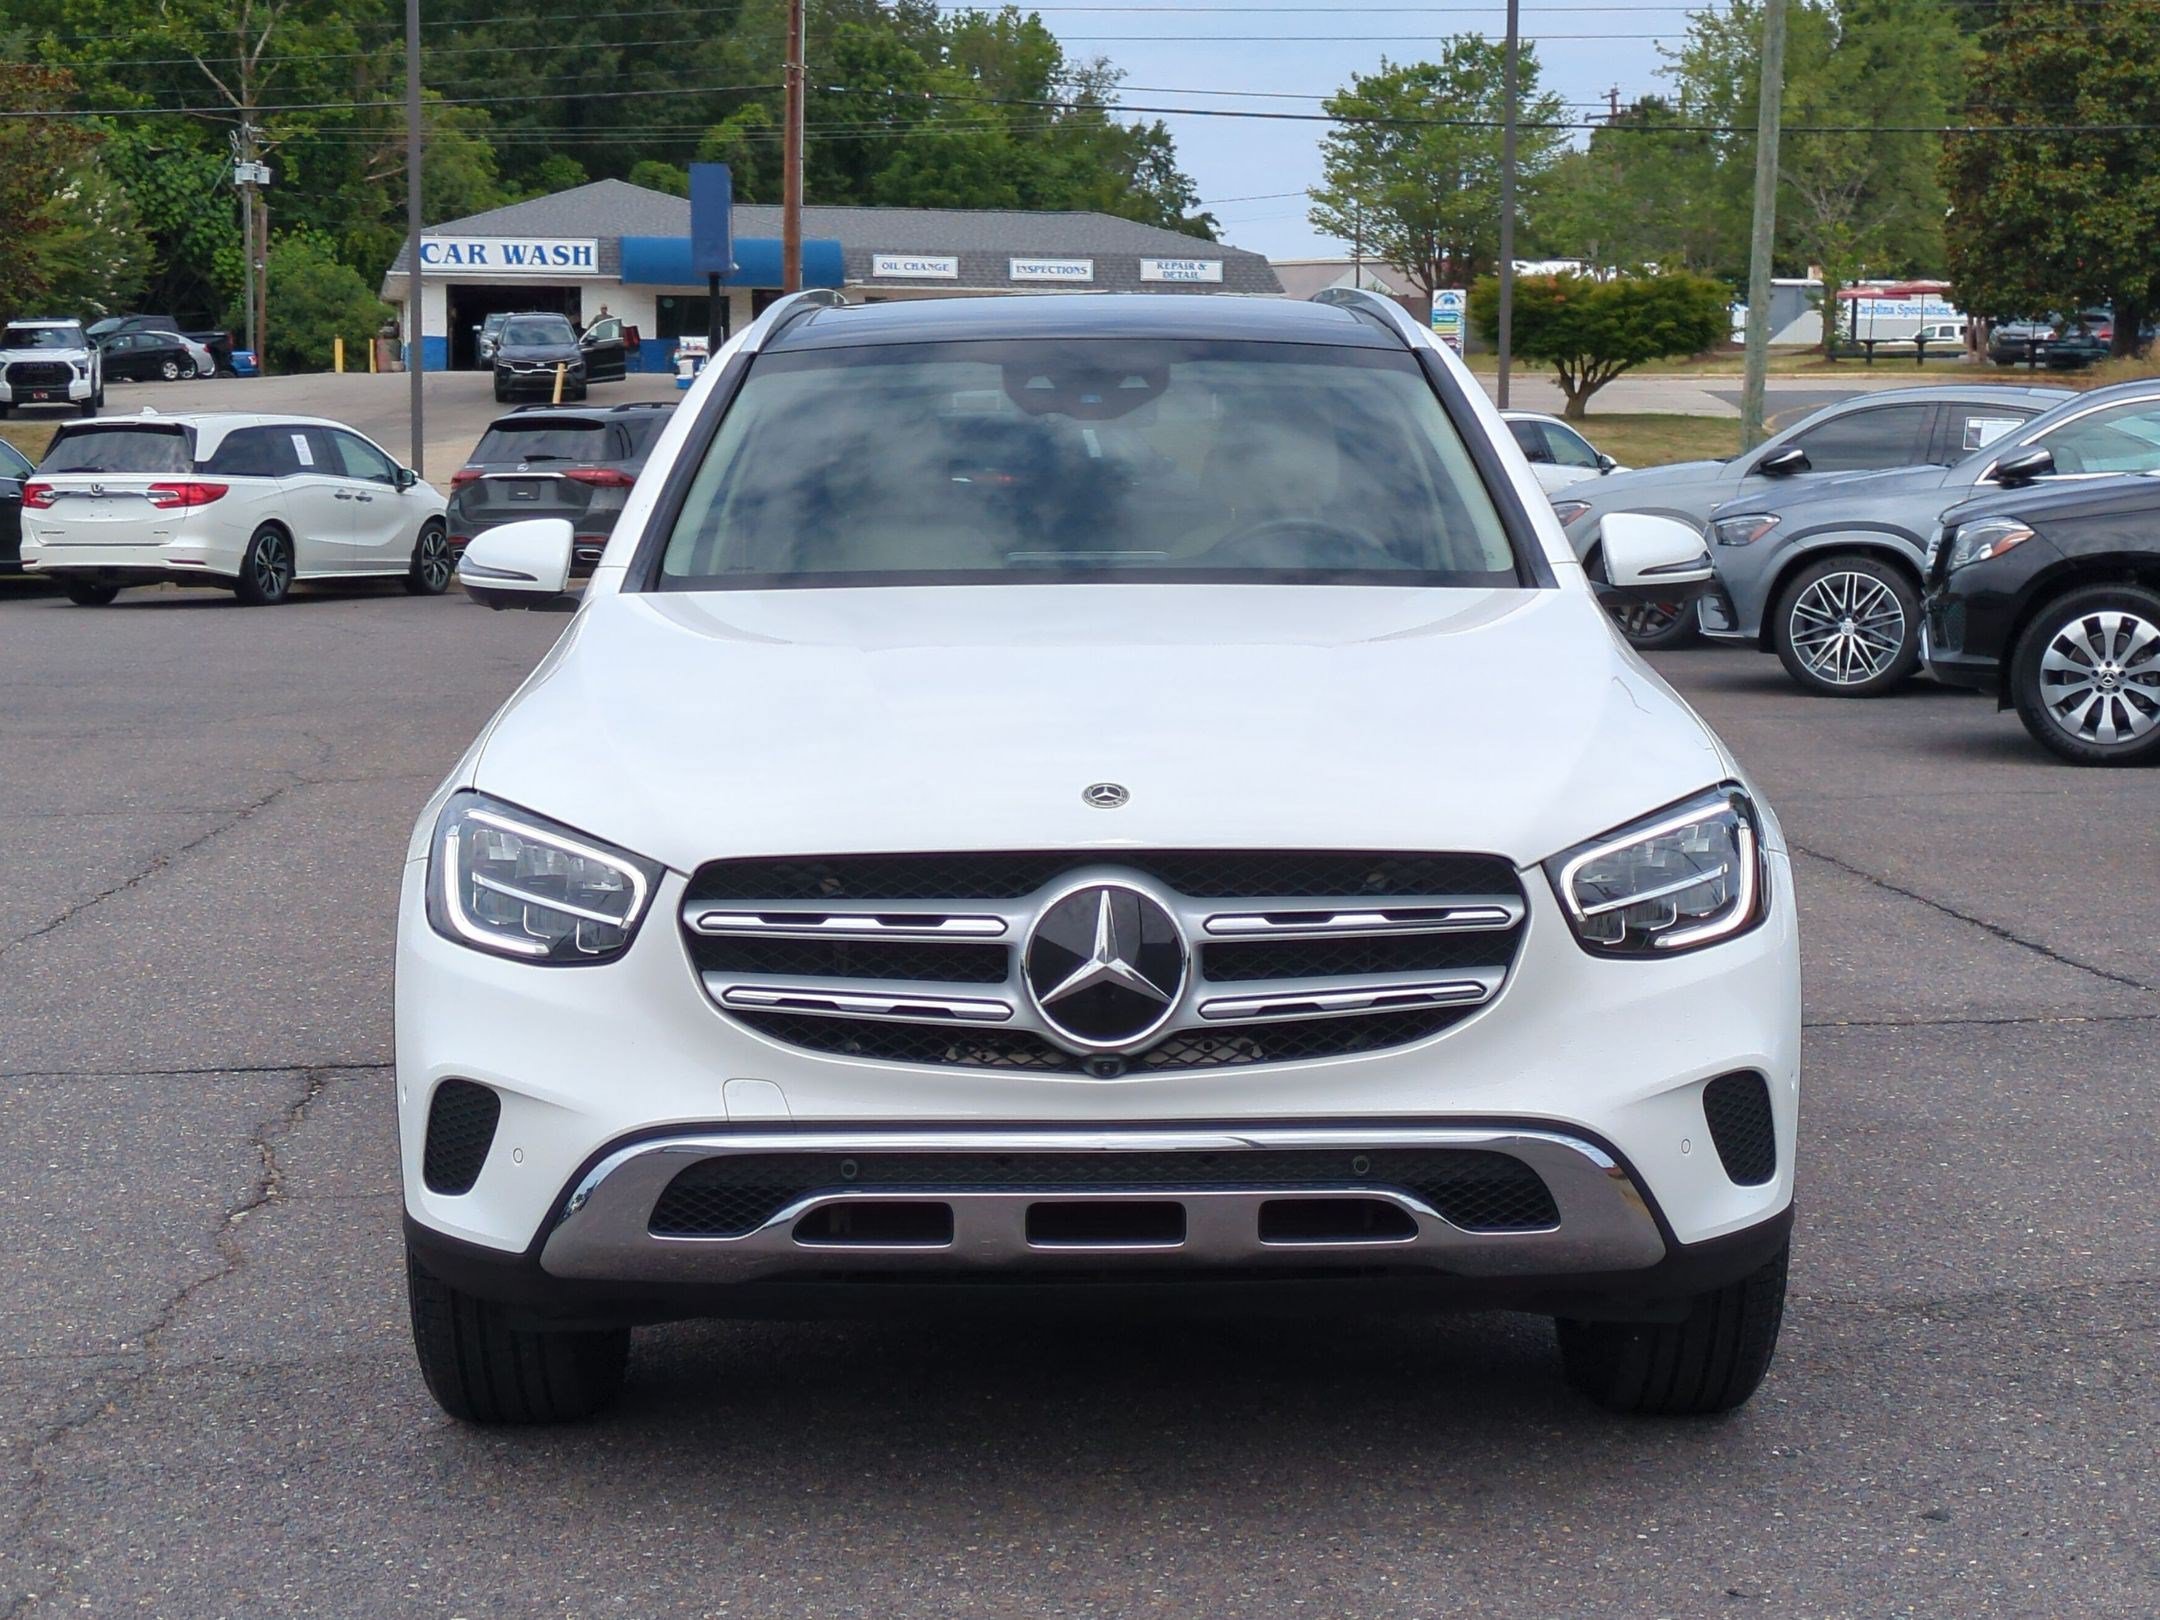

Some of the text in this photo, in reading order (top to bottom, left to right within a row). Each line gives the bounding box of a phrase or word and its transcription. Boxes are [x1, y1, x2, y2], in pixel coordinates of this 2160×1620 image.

[419, 243, 592, 266] CAR WASH
[881, 262, 950, 272] OIL CHANGE
[1015, 264, 1089, 275] INSPECTIONS
[1156, 261, 1208, 270] REPAIR &
[1162, 270, 1200, 279] DETAIL
[1897, 303, 1952, 318] Specalties,
